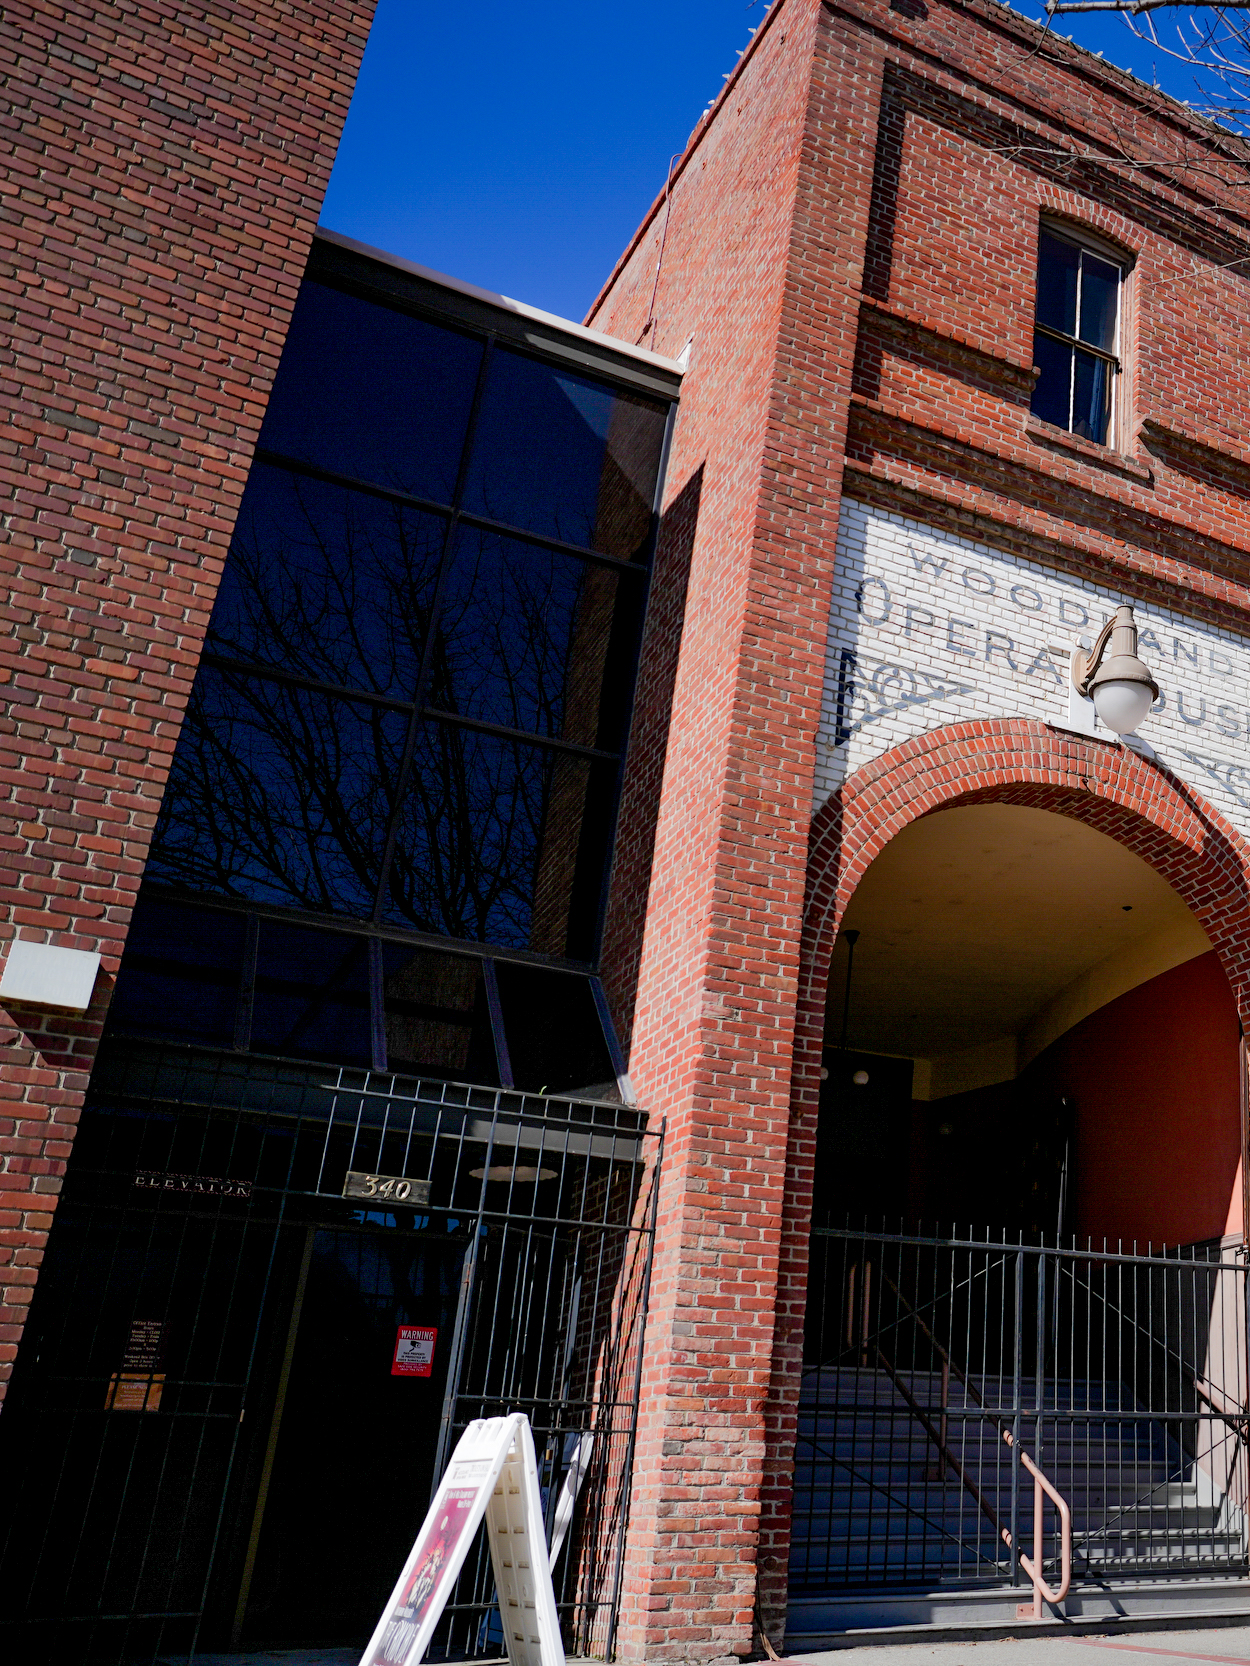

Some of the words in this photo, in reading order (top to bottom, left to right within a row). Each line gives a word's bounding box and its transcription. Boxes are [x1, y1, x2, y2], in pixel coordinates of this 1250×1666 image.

[855, 577, 1065, 686] OPERA
[135, 1174, 248, 1196] ELEVATOR
[361, 1175, 411, 1200] 340
[401, 1329, 434, 1341] WARNING
